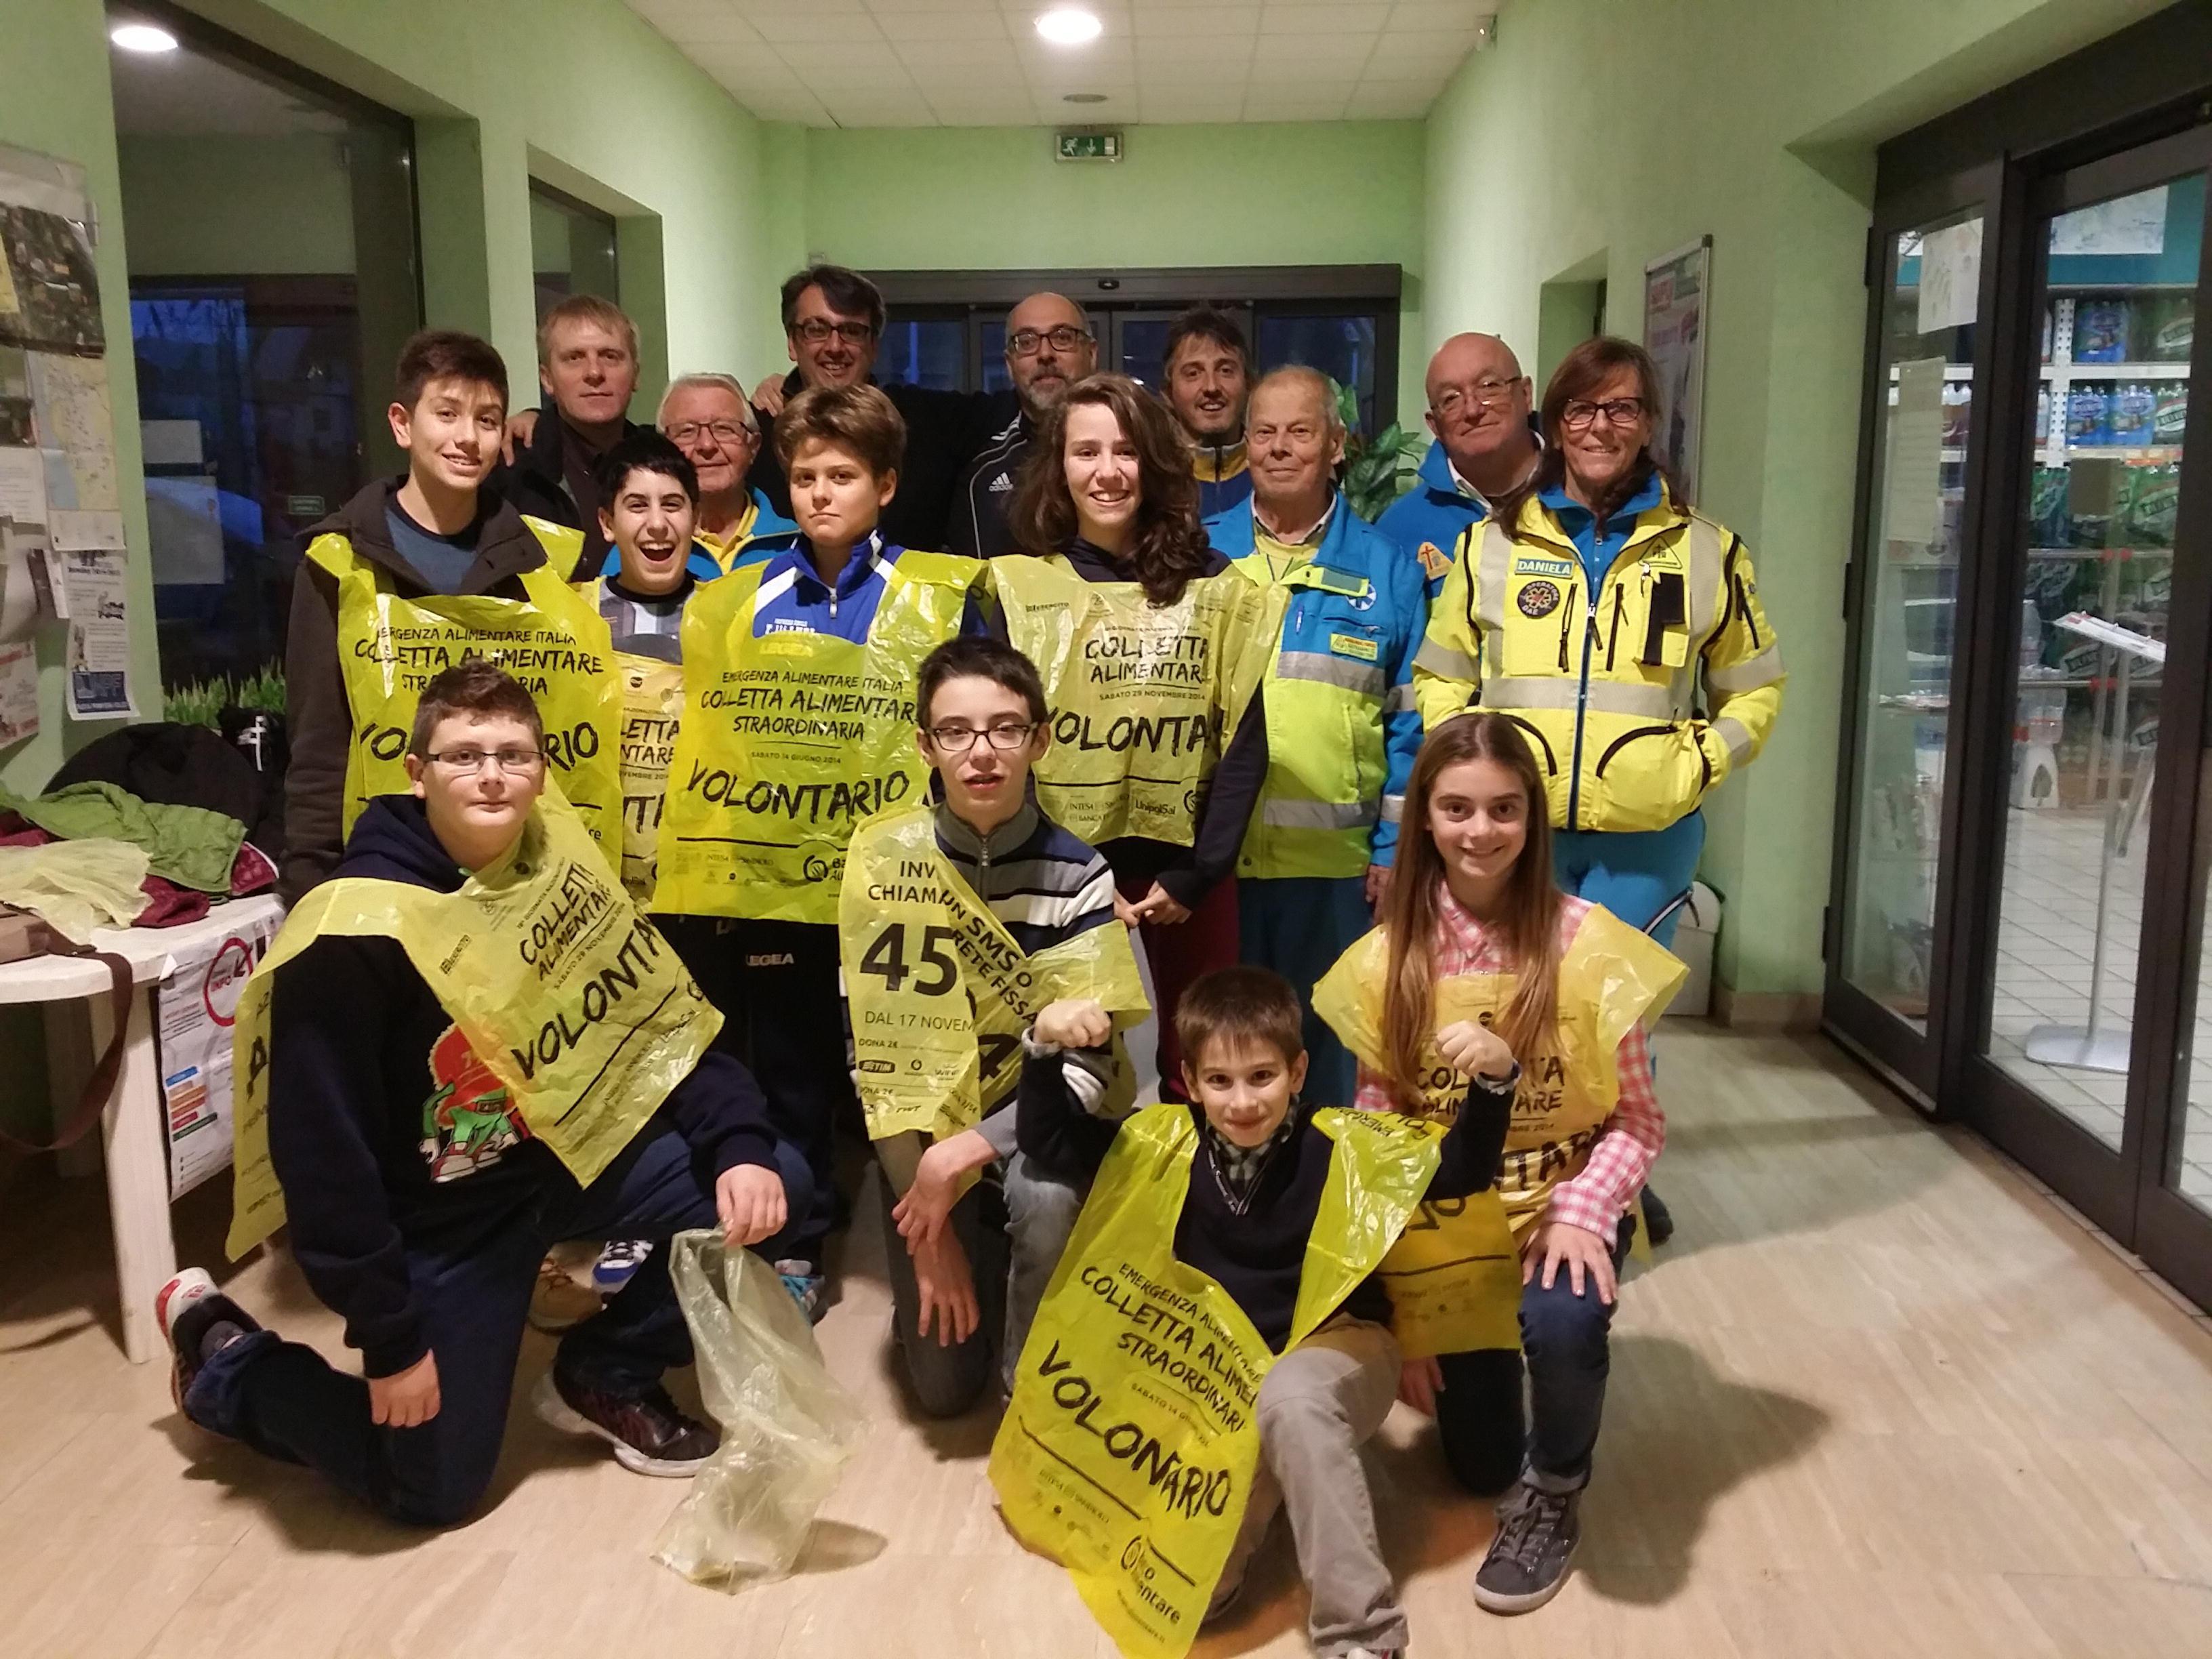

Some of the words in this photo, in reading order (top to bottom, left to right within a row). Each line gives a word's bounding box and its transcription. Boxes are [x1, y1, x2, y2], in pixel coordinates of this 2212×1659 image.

[1518, 560, 1570, 574] DANIELA
[445, 628, 531, 642] ALIMENTARE
[536, 631, 577, 646] ITALIA
[459, 646, 605, 676] ALIMENTARE
[1090, 661, 1204, 684] ALIMENTAR
[782, 672, 859, 689] ALIMENTARE
[862, 678, 903, 694] ITALIA
[701, 688, 783, 710] COLLETTA
[790, 690, 918, 725] ALIMENTAR
[1099, 691, 1130, 701] SABATO
[1144, 691, 1186, 701] NOVEMBRE
[733, 715, 865, 741] STRAORDINARIA
[751, 751, 780, 760] SABATO
[791, 754, 822, 763] GIUGNO
[823, 755, 842, 764] 2014
[687, 758, 910, 825] VOLONTARIO
[899, 860, 936, 879] INV
[951, 928, 994, 979] RETE
[966, 916, 1021, 972] SMS
[745, 953, 794, 966] LEGEA
[865, 1010, 895, 1025] DAL
[900, 1014, 916, 1027] 17
[920, 1016, 976, 1032] NOVEM
[1118, 1263, 1198, 1319] EMERGENZA
[1080, 1265, 1195, 1354] COLLETTA
[1118, 1332, 1245, 1433] STRAORDINARI
